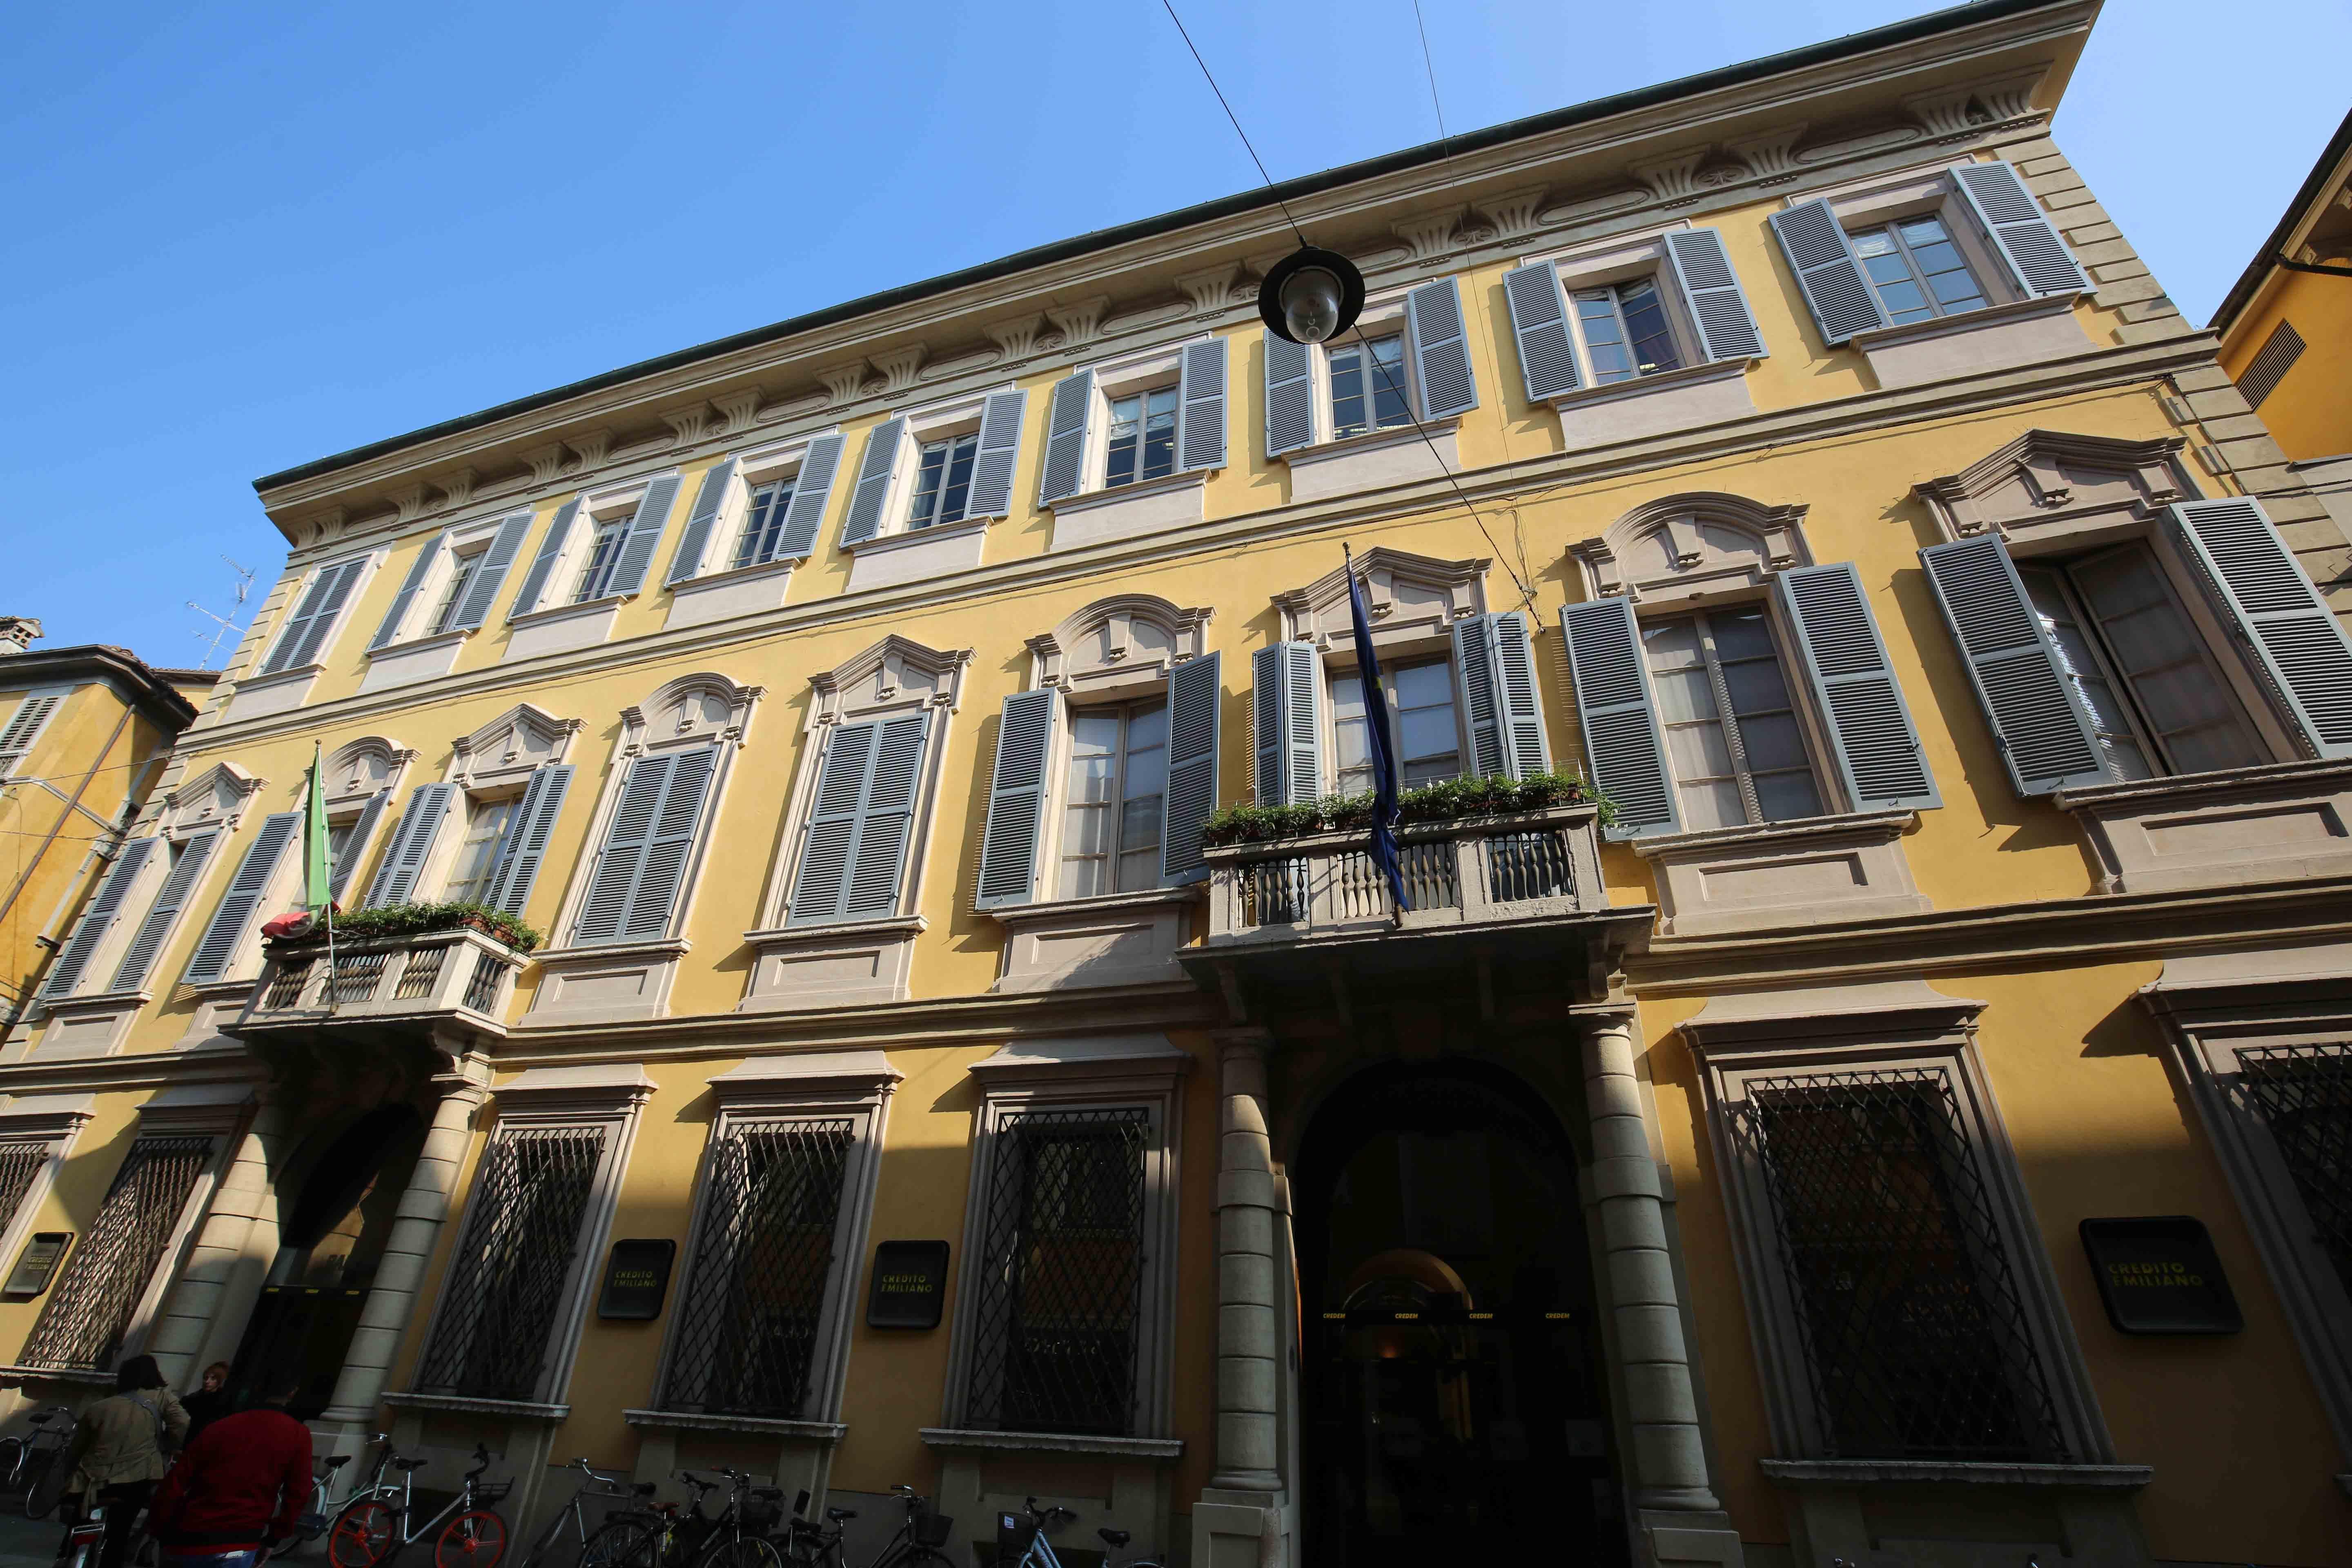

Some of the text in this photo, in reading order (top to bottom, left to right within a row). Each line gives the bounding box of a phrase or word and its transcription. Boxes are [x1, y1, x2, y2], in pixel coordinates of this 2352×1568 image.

[2109, 1262, 2185, 1274] CREDITO
[882, 1274, 927, 1282] CREDITO
[2113, 1274, 2203, 1287] EMILIANO
[881, 1283, 933, 1292] EMILIANO
